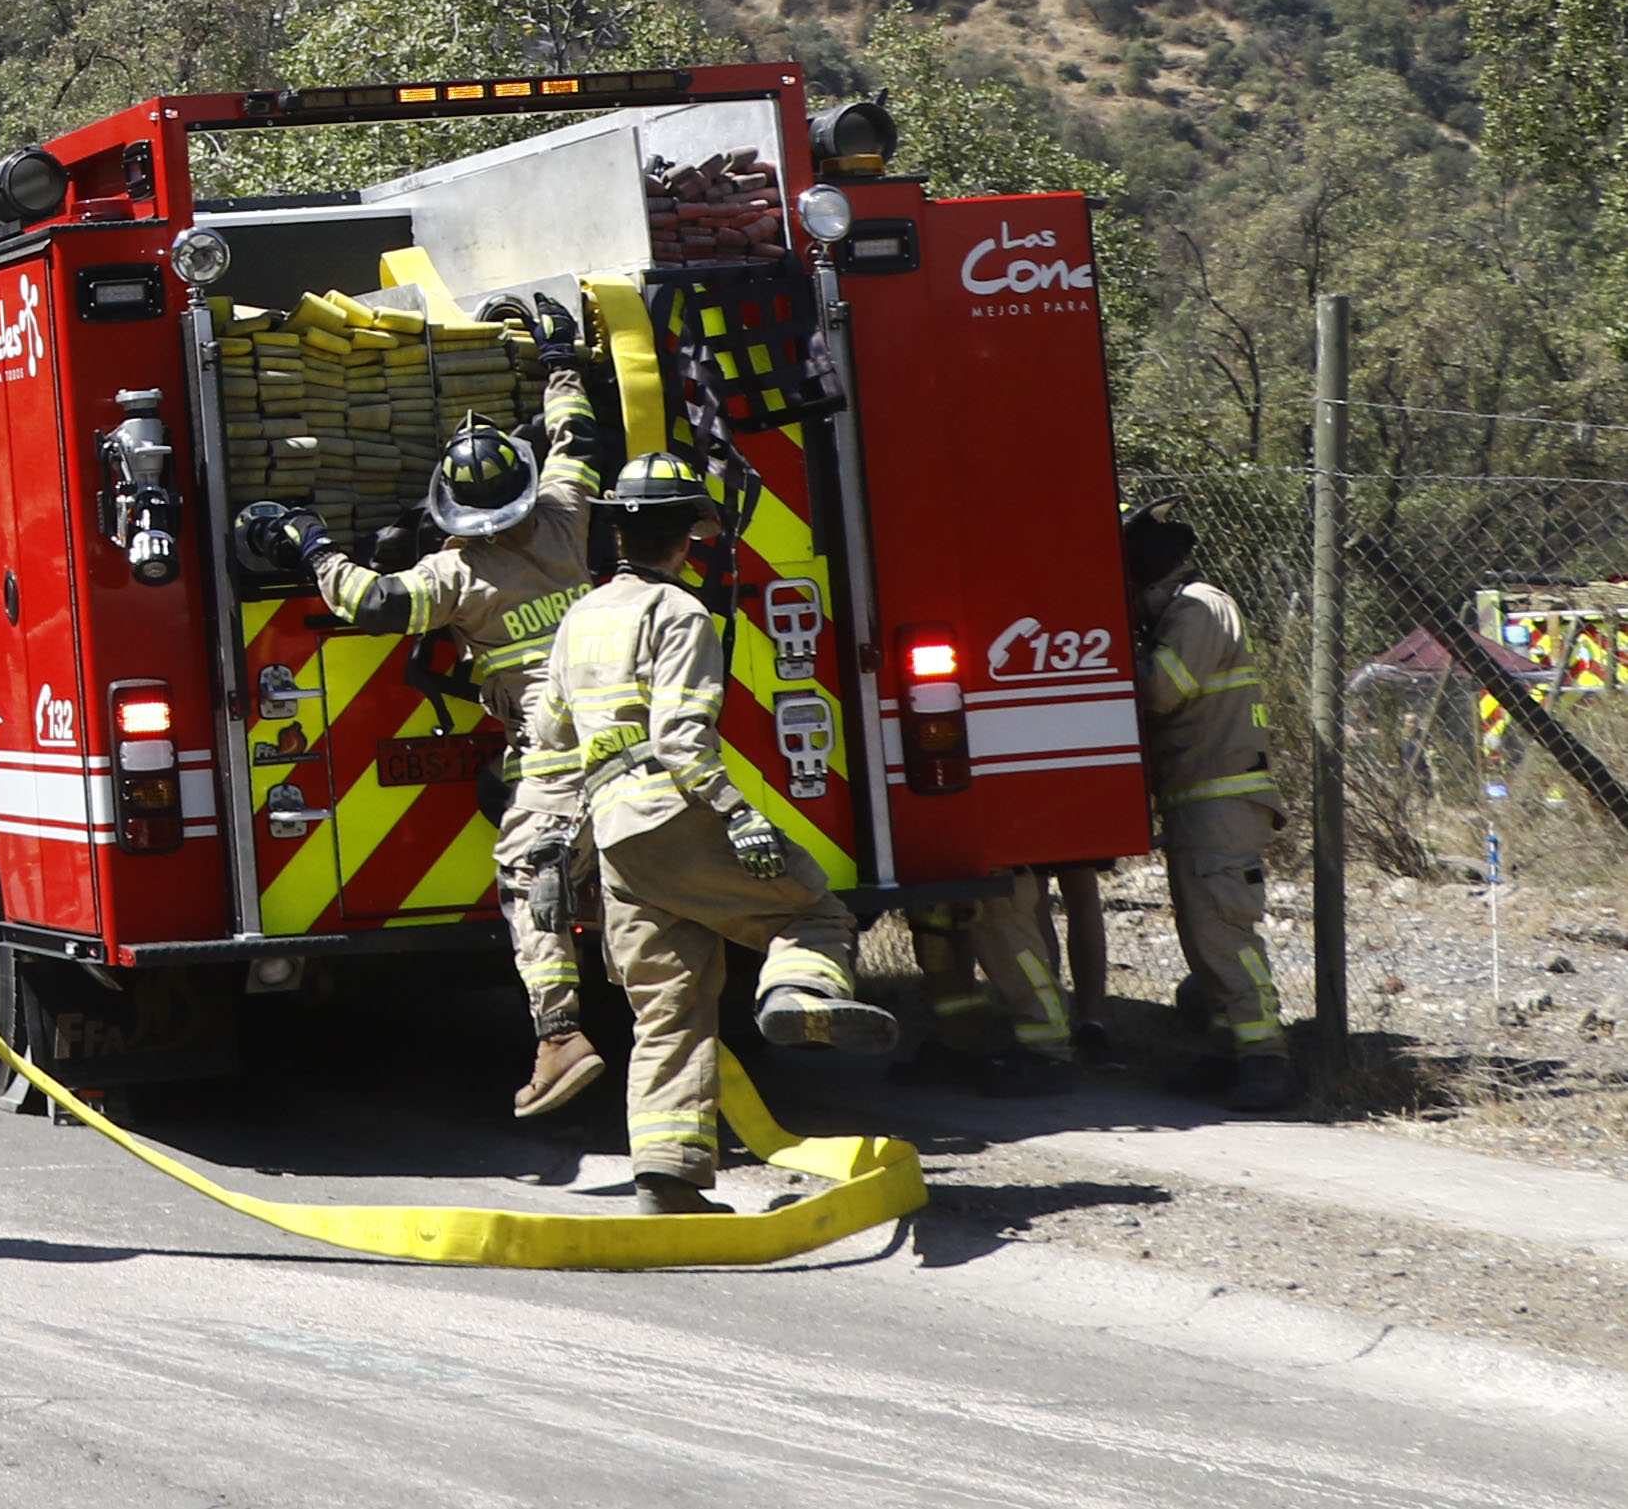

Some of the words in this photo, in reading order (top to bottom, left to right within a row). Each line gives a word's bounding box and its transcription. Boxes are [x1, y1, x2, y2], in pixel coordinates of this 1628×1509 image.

[1001, 220, 1057, 250] Las
[972, 303, 1032, 318] MEJOR
[1043, 299, 1090, 313] PARA
[1029, 628, 1112, 672] 132
[47, 699, 74, 740] 132
